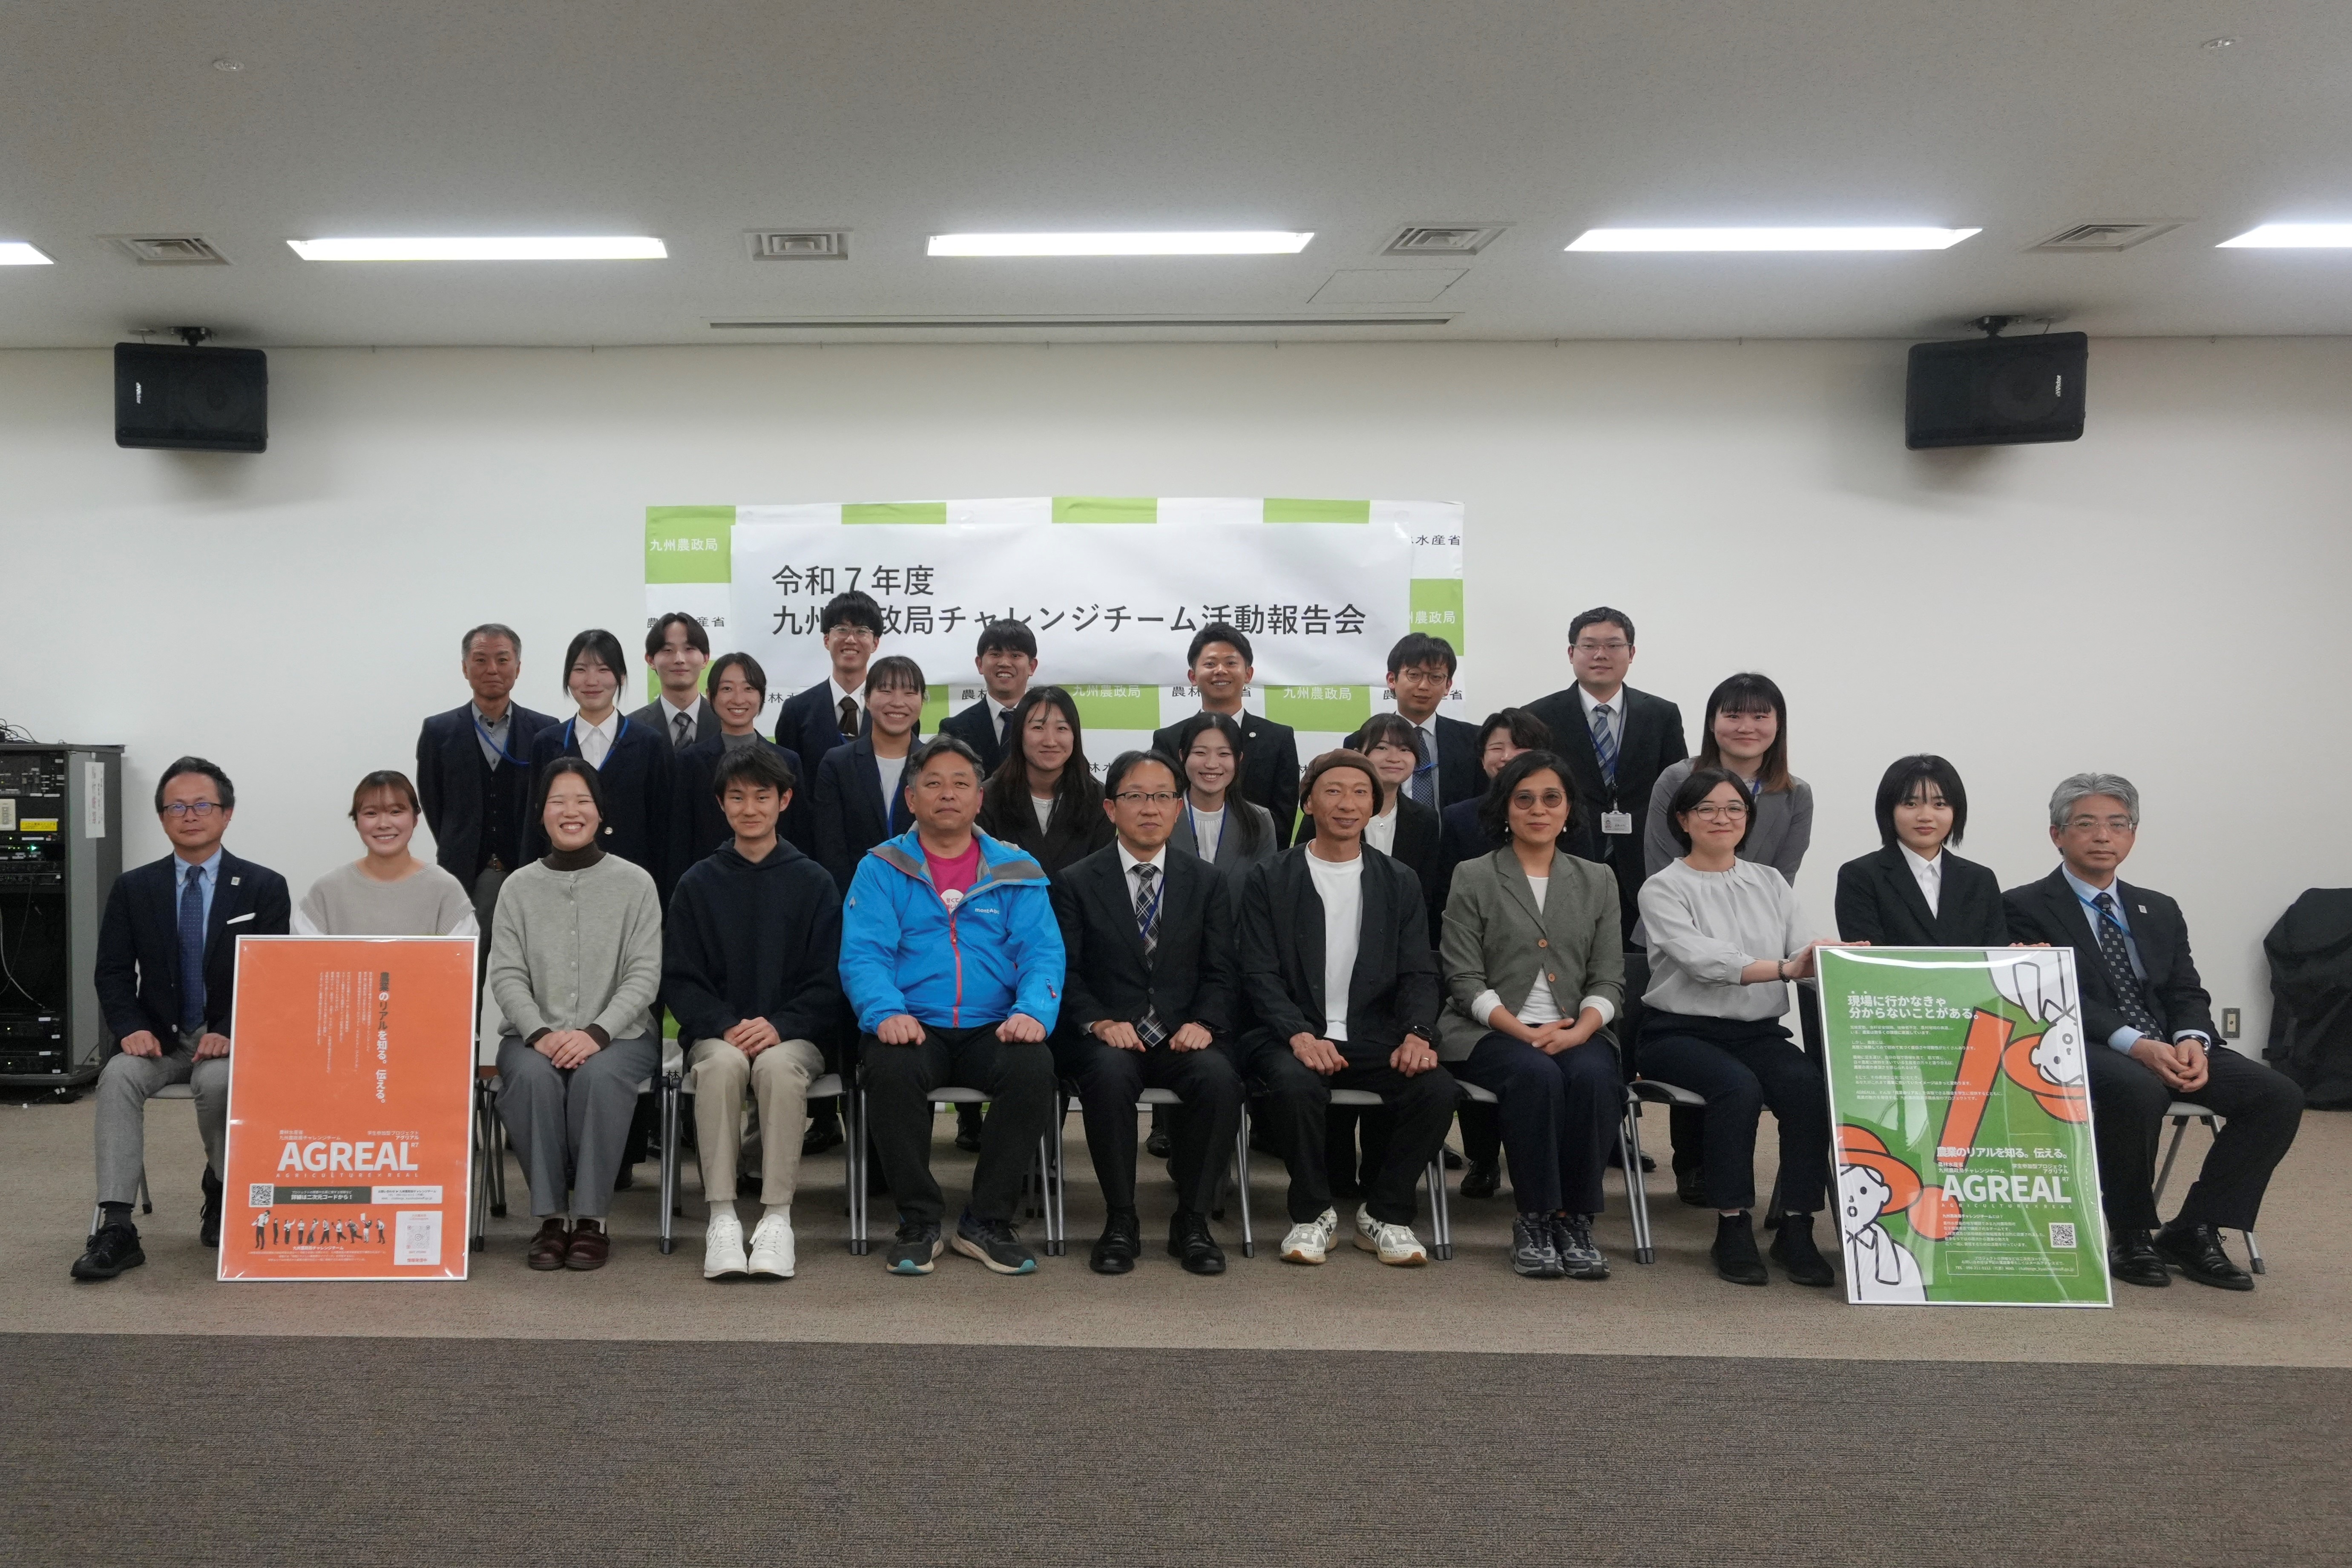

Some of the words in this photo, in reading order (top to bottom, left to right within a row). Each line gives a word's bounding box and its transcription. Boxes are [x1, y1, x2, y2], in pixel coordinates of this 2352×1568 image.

[650, 538, 718, 552] 九州農政局
[1412, 535, 1460, 545] 水産省
[647, 617, 725, 628] 農産省
[772, 604, 1366, 635] 九州政局チャンジチーム活動報告会
[1409, 611, 1455, 624] 農政局
[1072, 685, 1141, 698] 九州農政局
[1172, 686, 1251, 697] 農林省
[1283, 686, 1351, 700] 九州農政局
[1847, 995, 1947, 1007] 現場に行かなきゃ
[1849, 1007, 1979, 1019] 分からないことがある。
[277, 1141, 418, 1171] AGREAL
[1941, 1174, 2072, 1203] AGREAL
